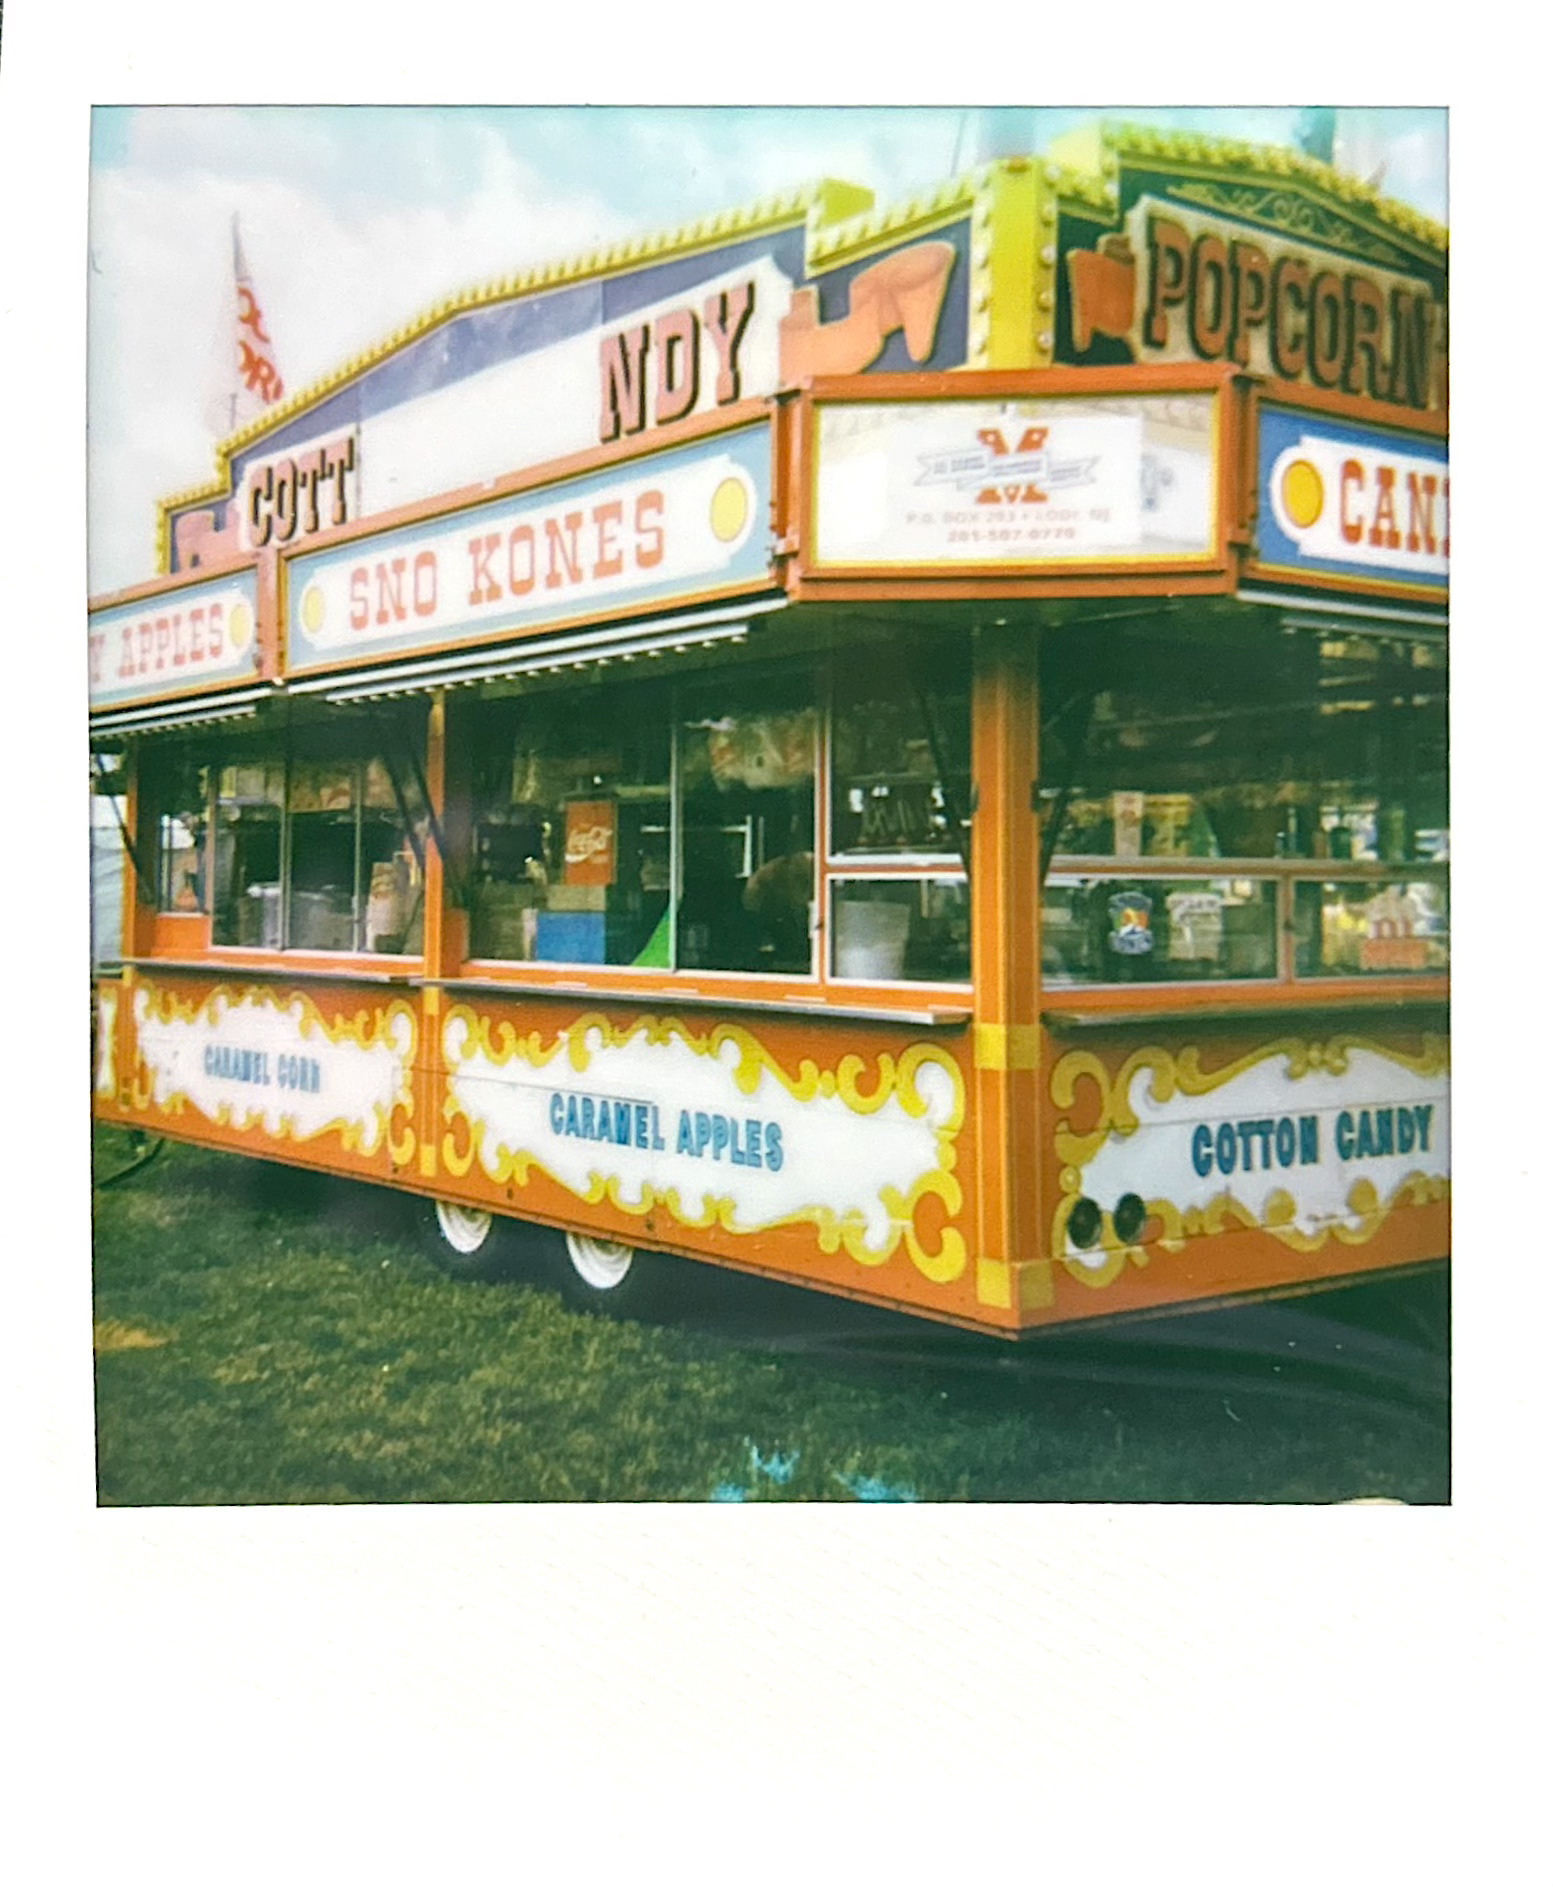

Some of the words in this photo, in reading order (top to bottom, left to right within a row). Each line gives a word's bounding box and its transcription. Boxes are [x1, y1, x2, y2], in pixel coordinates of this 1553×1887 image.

[1143, 214, 1430, 411] POPCORN
[249, 436, 355, 547] COTT
[599, 281, 756, 444] NDY
[1339, 458, 1450, 560] CAN
[348, 550, 438, 632] SNO
[467, 489, 665, 607] KONES
[117, 603, 224, 679] APPLES
[203, 1043, 271, 1086] CARAMEL
[277, 1053, 322, 1094] CORN
[550, 1092, 666, 1151] CARAMEL
[676, 1109, 785, 1173] APPLES
[1191, 1115, 1319, 1178] COTTON
[1335, 1103, 1434, 1162] CANDY
